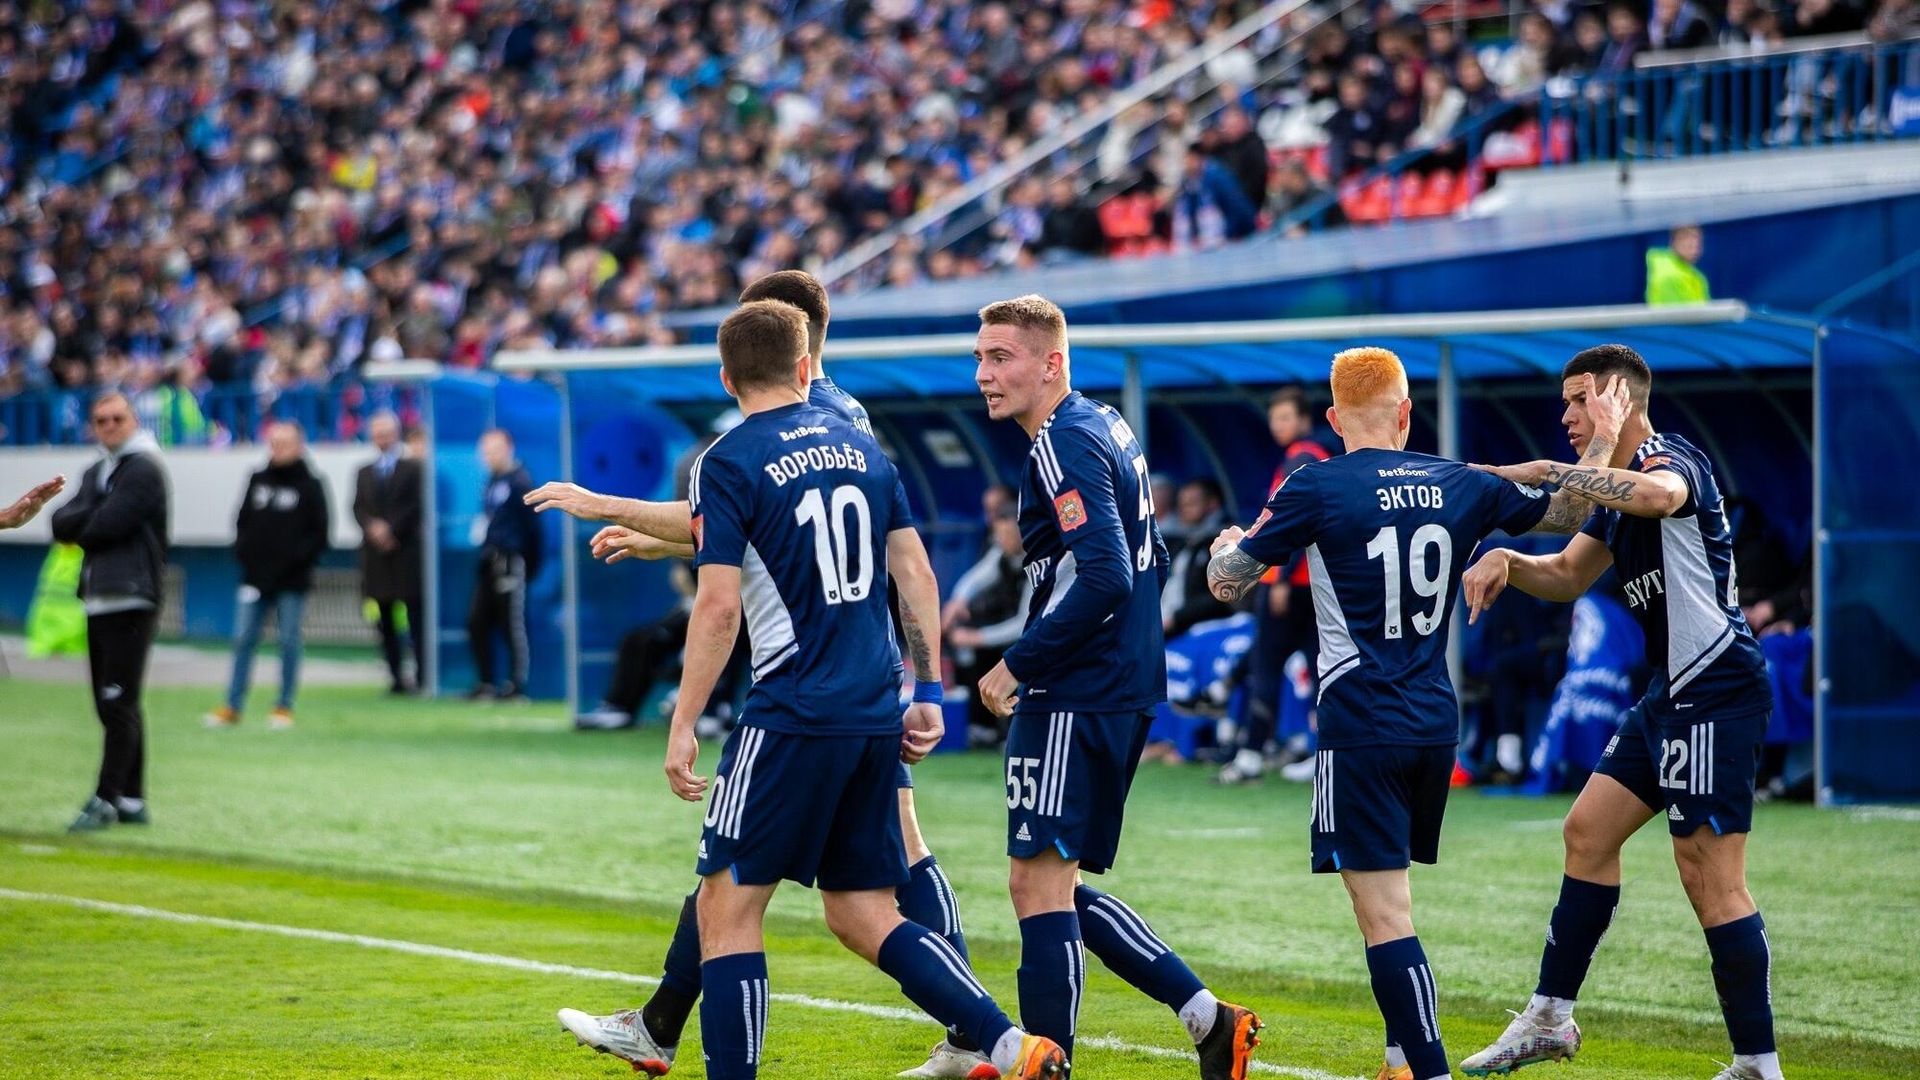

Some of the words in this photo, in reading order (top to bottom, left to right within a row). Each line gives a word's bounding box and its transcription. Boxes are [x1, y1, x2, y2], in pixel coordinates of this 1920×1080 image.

[764, 442, 867, 487] ВОРОБЬЁВ
[1377, 467, 1429, 477] BetBoom
[1376, 485, 1443, 511] ЭКТОВ
[794, 485, 874, 605] 10
[1366, 524, 1453, 639] 19
[1007, 756, 1040, 810] 55
[1659, 739, 1689, 789] 22
